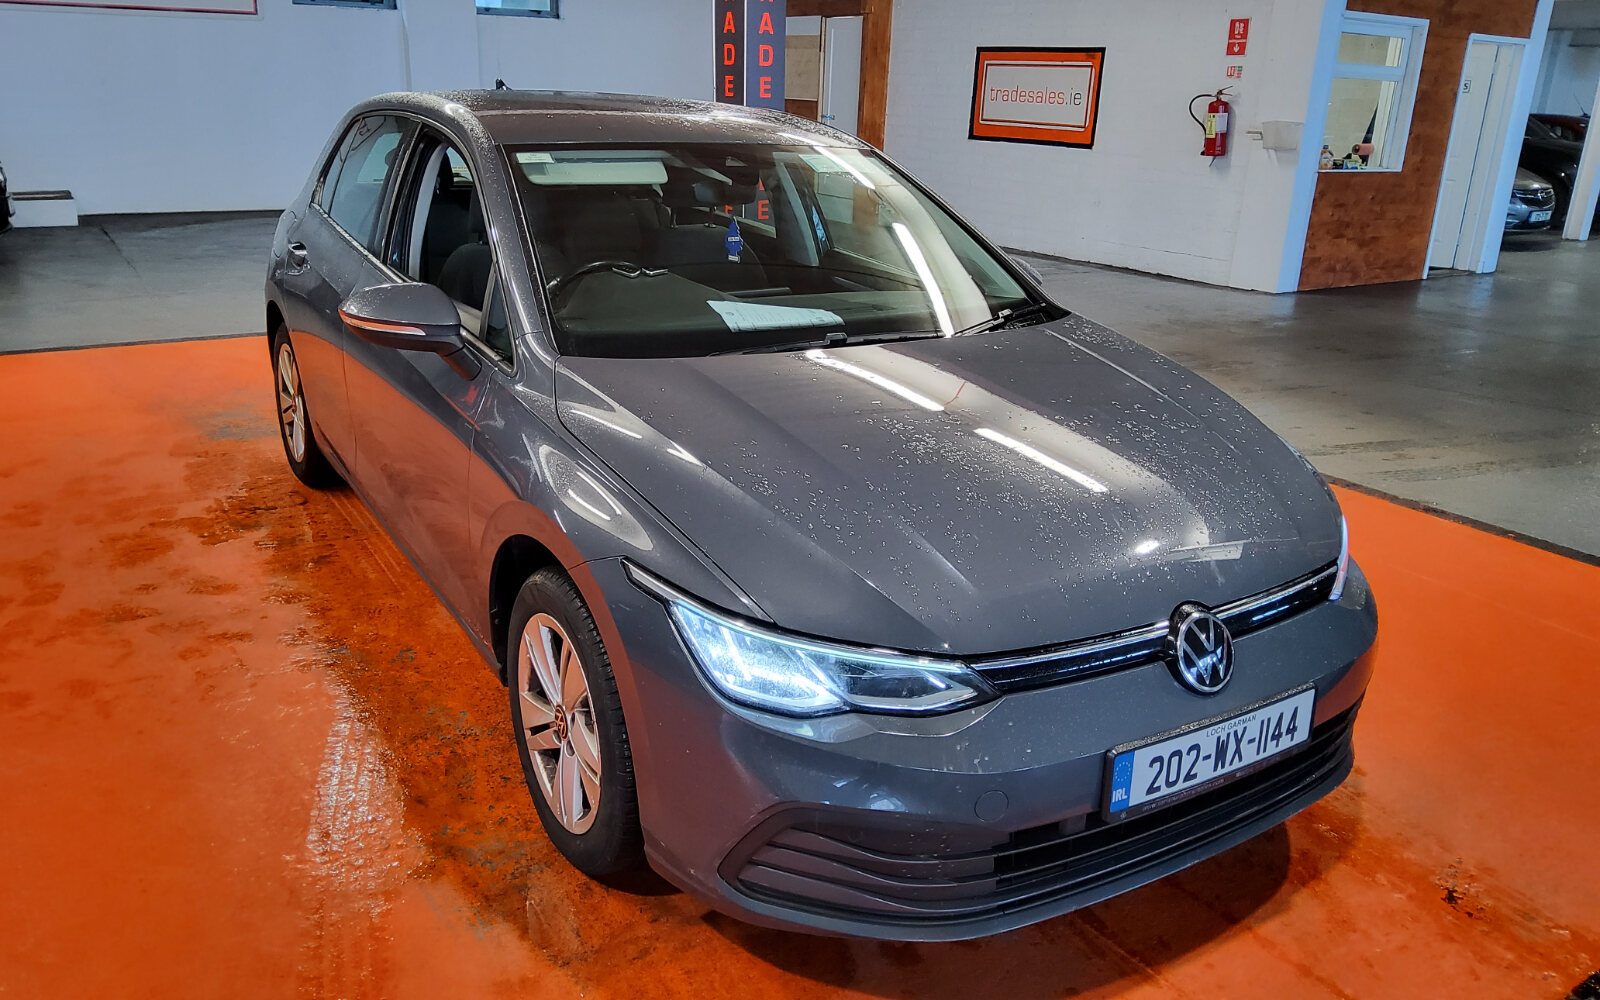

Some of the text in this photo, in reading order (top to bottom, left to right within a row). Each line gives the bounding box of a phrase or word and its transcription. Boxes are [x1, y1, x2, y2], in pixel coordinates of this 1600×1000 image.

[723, 0, 736, 97] ADE
[758, 0, 774, 98] ADE
[990, 85, 1082, 106] tradesales.ie
[1145, 706, 1298, 796] 202-WX-1144
[1206, 714, 1257, 738] LOCH GARMAN
[1112, 788, 1128, 803] IRL
